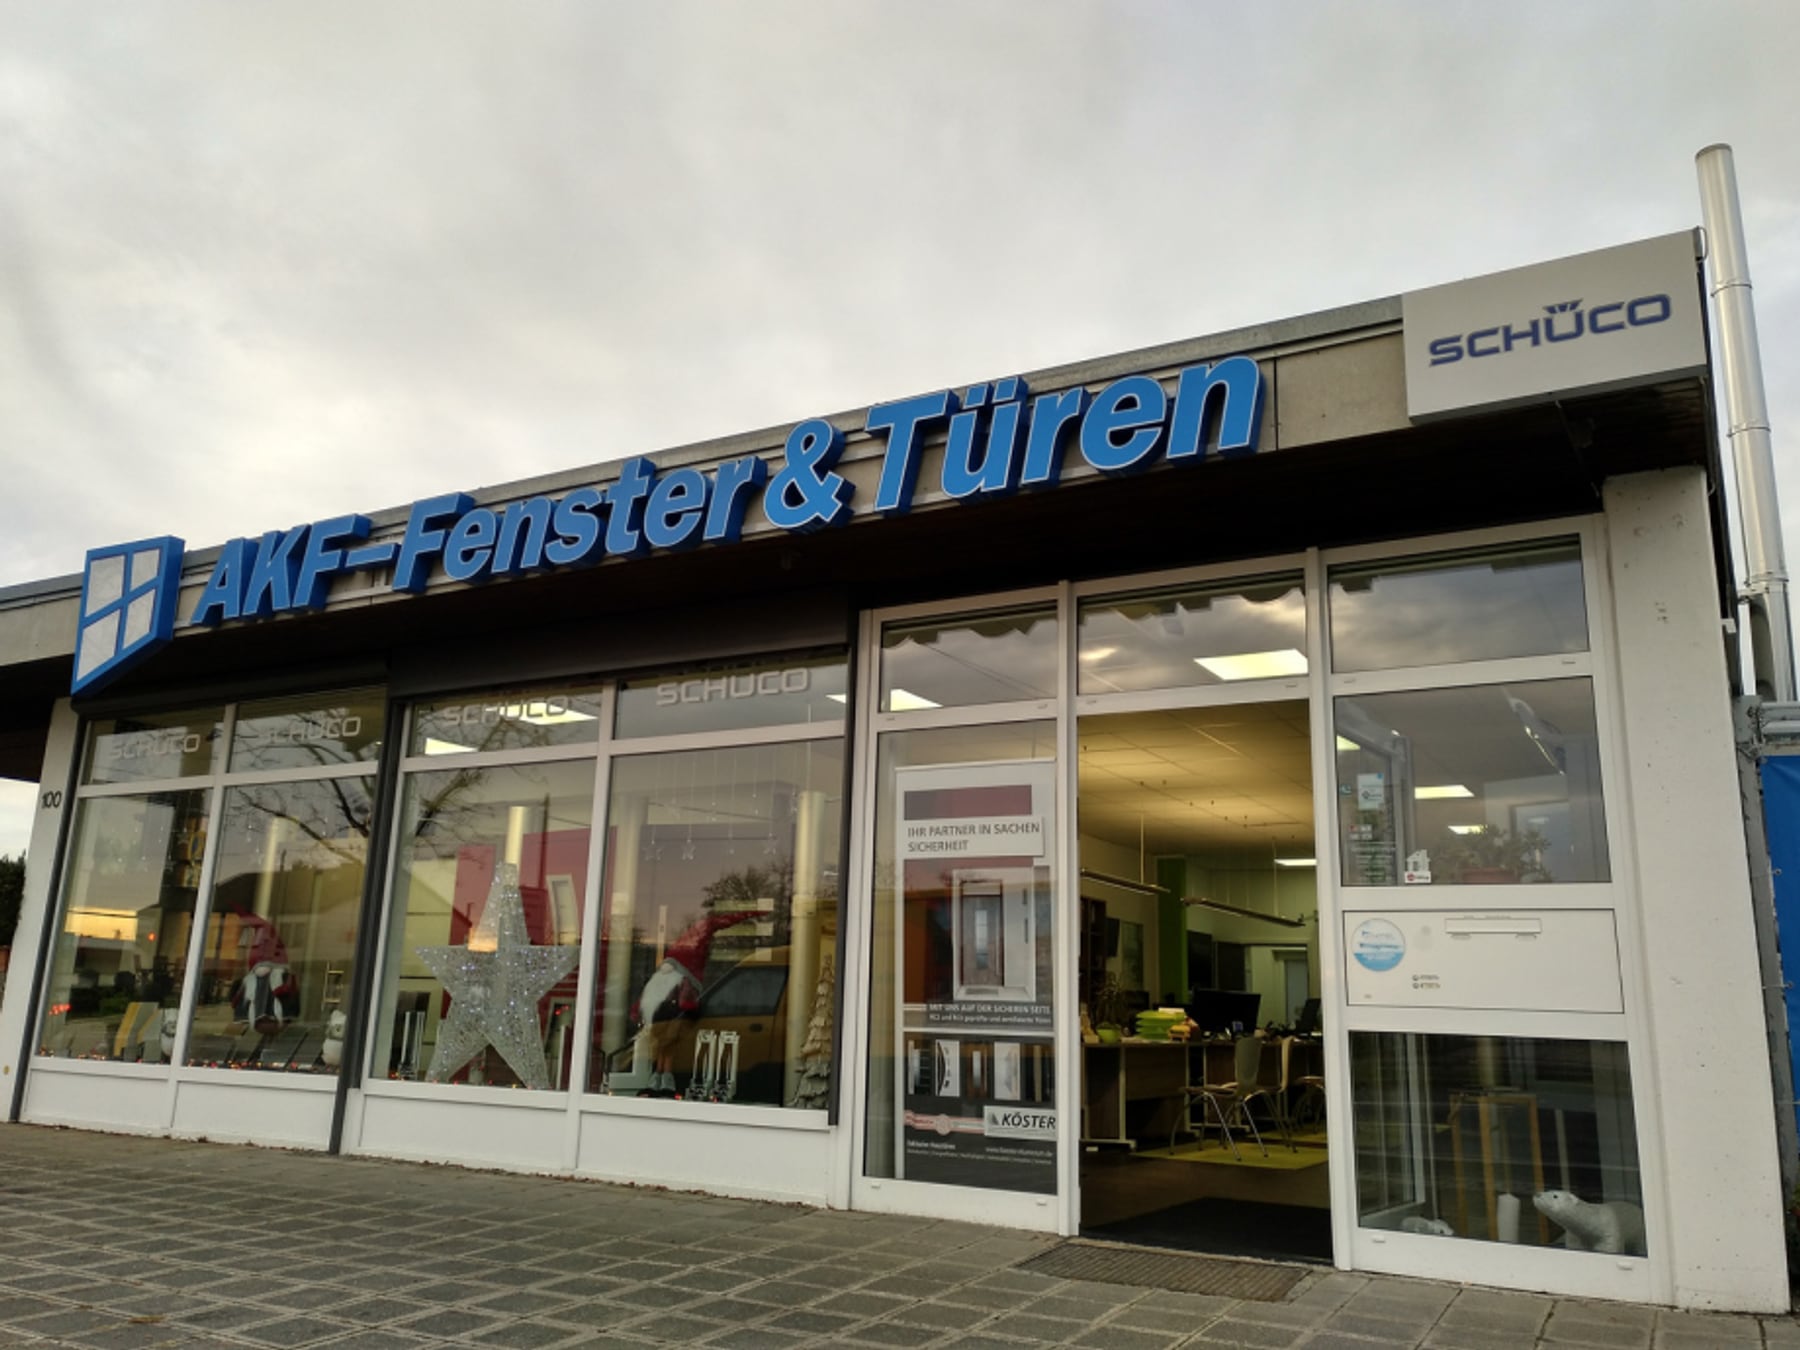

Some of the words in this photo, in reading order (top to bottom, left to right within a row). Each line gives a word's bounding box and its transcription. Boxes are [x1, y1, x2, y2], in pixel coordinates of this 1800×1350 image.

[1429, 293, 1672, 367] SCHÜCO
[190, 456, 766, 627] AKF-Fenster
[763, 418, 852, 532] &
[865, 355, 1263, 512] Türen
[42, 790, 62, 809] 100
[907, 827, 927, 837] IHR
[929, 824, 976, 837] PARTNER
[979, 824, 991, 834] IN
[994, 822, 1040, 834] SACHEN
[908, 839, 969, 852] SICHERHEIT
[961, 1004, 976, 1012] AUF
[1002, 1111, 1057, 1129] KÖSTER
